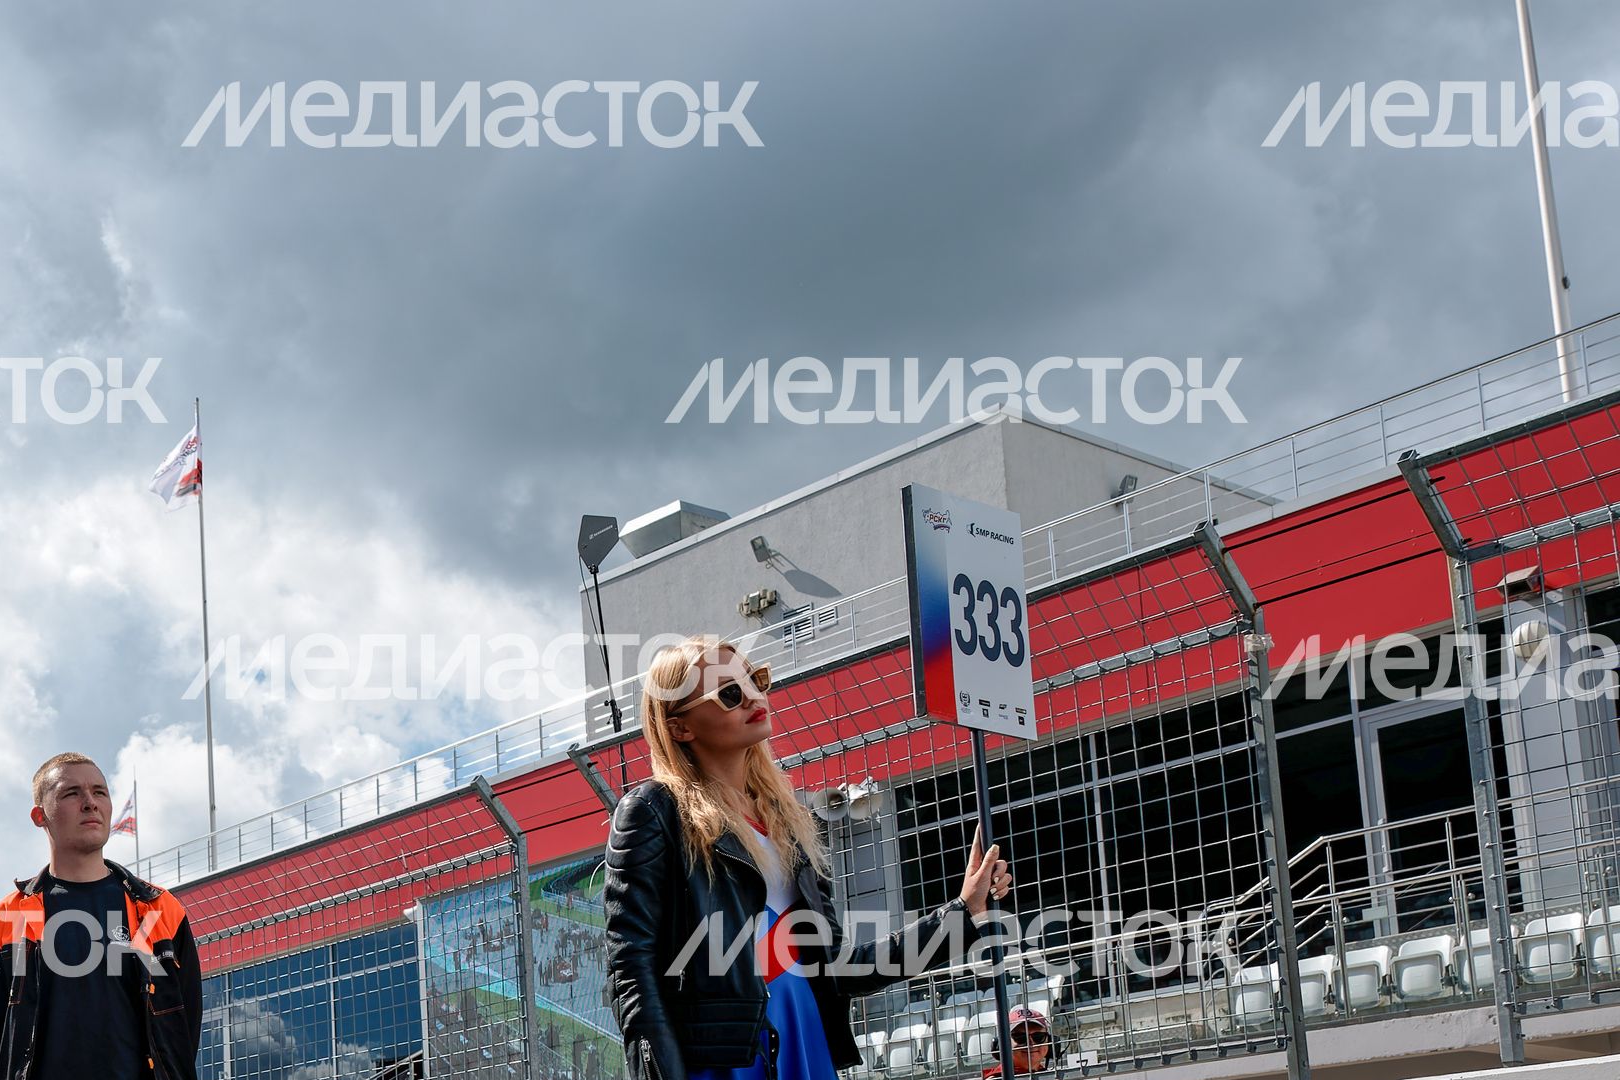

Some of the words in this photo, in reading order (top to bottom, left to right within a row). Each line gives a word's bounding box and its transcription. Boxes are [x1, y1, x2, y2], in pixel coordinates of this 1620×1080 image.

[975, 527, 990, 538] SMP
[990, 532, 1015, 545] RACING
[952, 573, 1025, 668] 333
